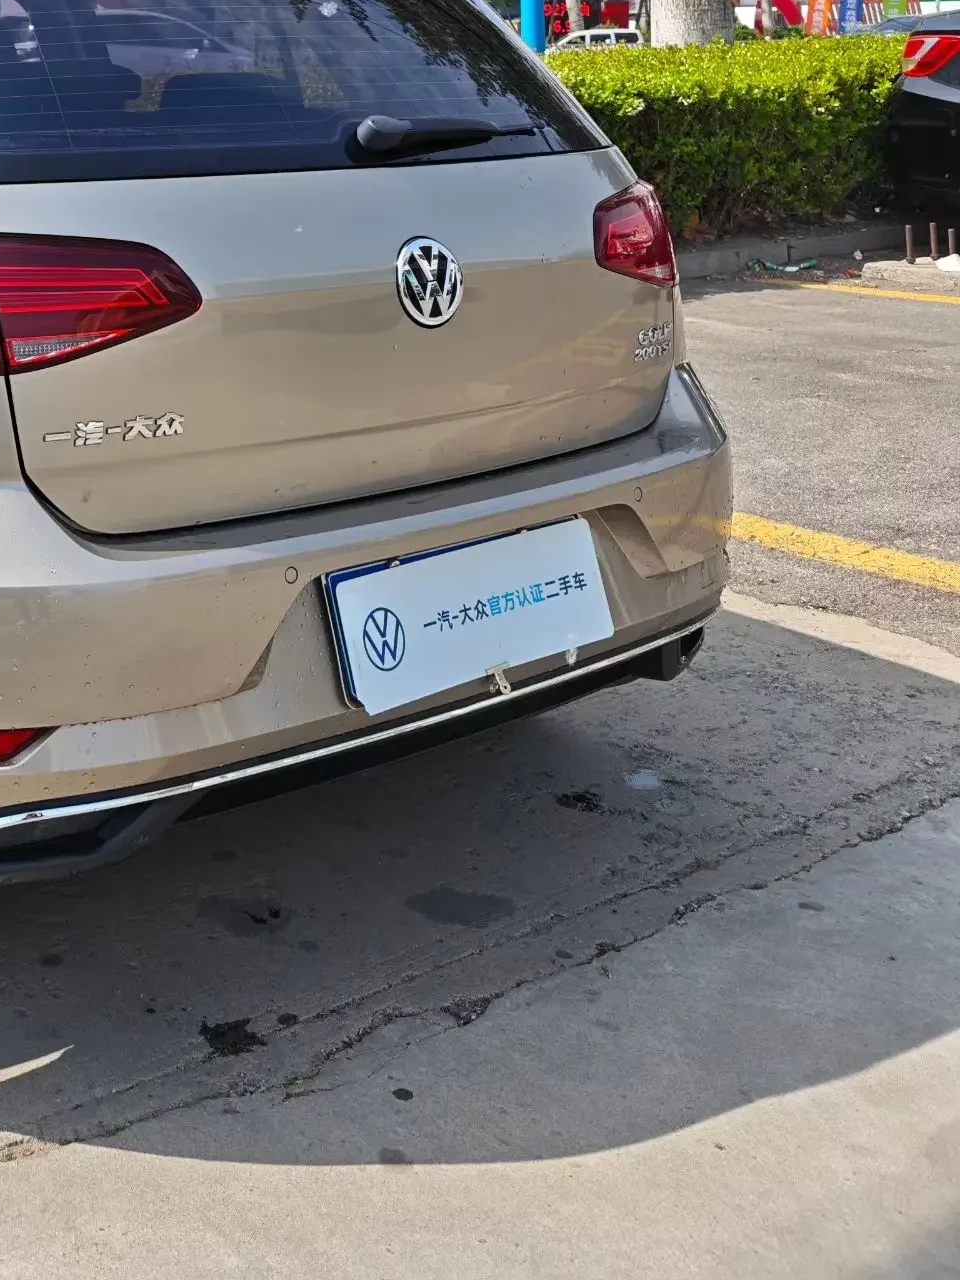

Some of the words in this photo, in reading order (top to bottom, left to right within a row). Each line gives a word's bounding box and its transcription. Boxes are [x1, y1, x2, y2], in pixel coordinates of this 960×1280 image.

[43, 411, 185, 447] 一汽-大众
[423, 572, 588, 632] 一汽-大众官方认证二手车
